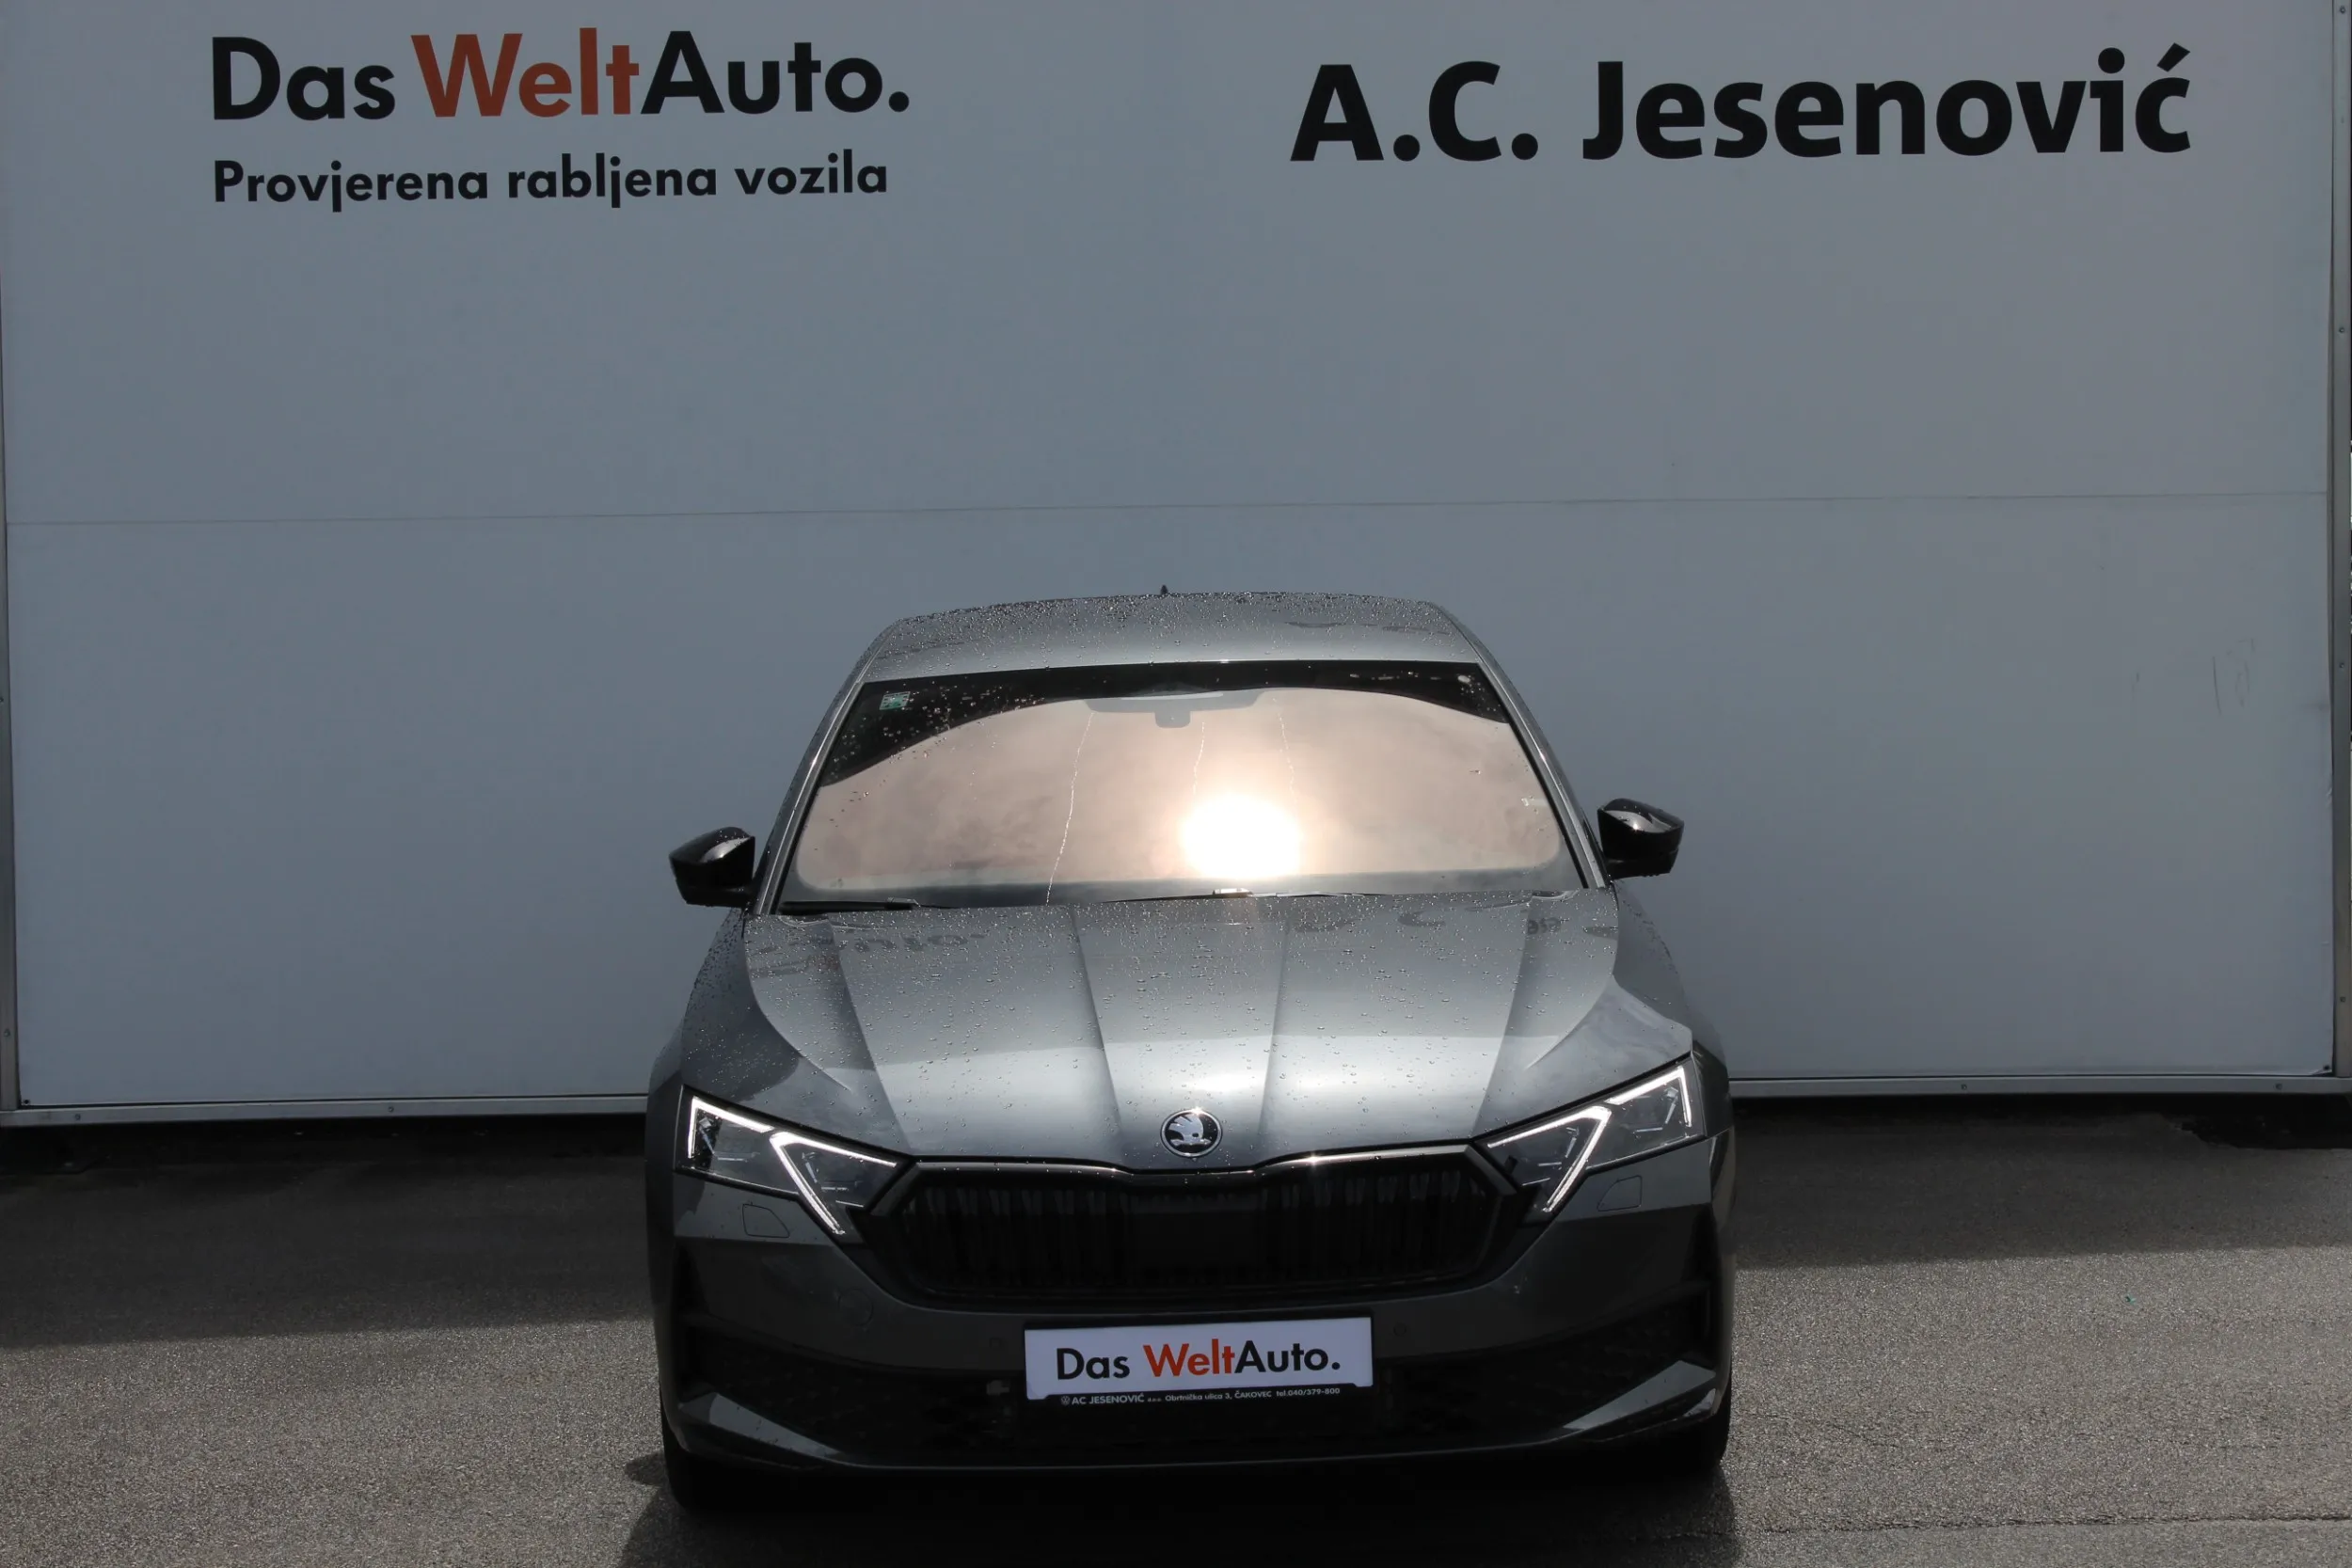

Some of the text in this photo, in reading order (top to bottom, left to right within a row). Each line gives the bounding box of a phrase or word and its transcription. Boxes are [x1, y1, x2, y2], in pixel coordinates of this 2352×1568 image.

[213, 28, 909, 120] Das WeltAuto.
[1291, 43, 2190, 161] A.C. Jesenović
[215, 149, 886, 213] Provjerena rabljena vozila
[1057, 1338, 1340, 1380] Das WeltAuto.
[1072, 1396, 1087, 1405] AC
[1089, 1393, 1144, 1404] JESENOVIĆ
[1205, 1392, 1222, 1401] ulica
[1234, 1390, 1272, 1399] ČAKOVEC
